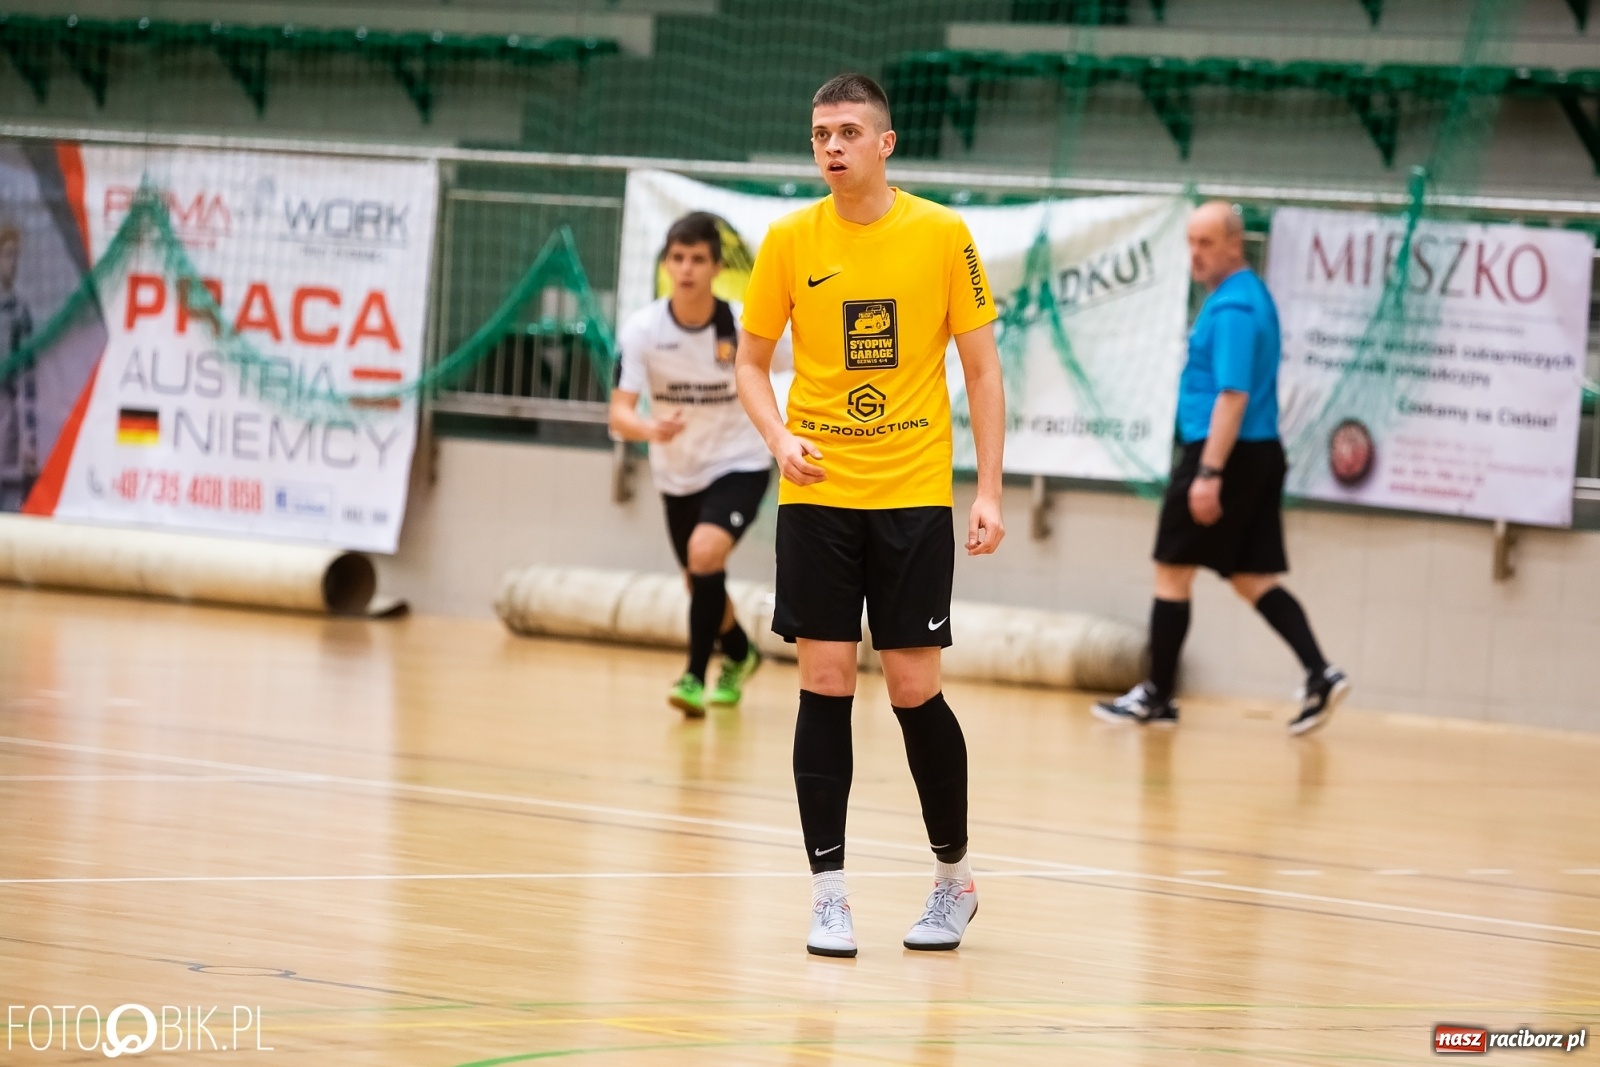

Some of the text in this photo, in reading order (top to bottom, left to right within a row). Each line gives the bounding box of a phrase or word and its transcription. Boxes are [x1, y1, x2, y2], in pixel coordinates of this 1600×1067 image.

[283, 196, 411, 242] WORK
[963, 243, 986, 309] WINDAR
[1306, 227, 1549, 306] MIESZKO
[123, 272, 403, 350] PRACA
[850, 339, 893, 350] STOPIW
[850, 349, 894, 360] GARAGE
[118, 347, 343, 404] AUSTRIA
[173, 406, 401, 471] NIEMCY
[820, 418, 929, 437] PRODUCTIONS
